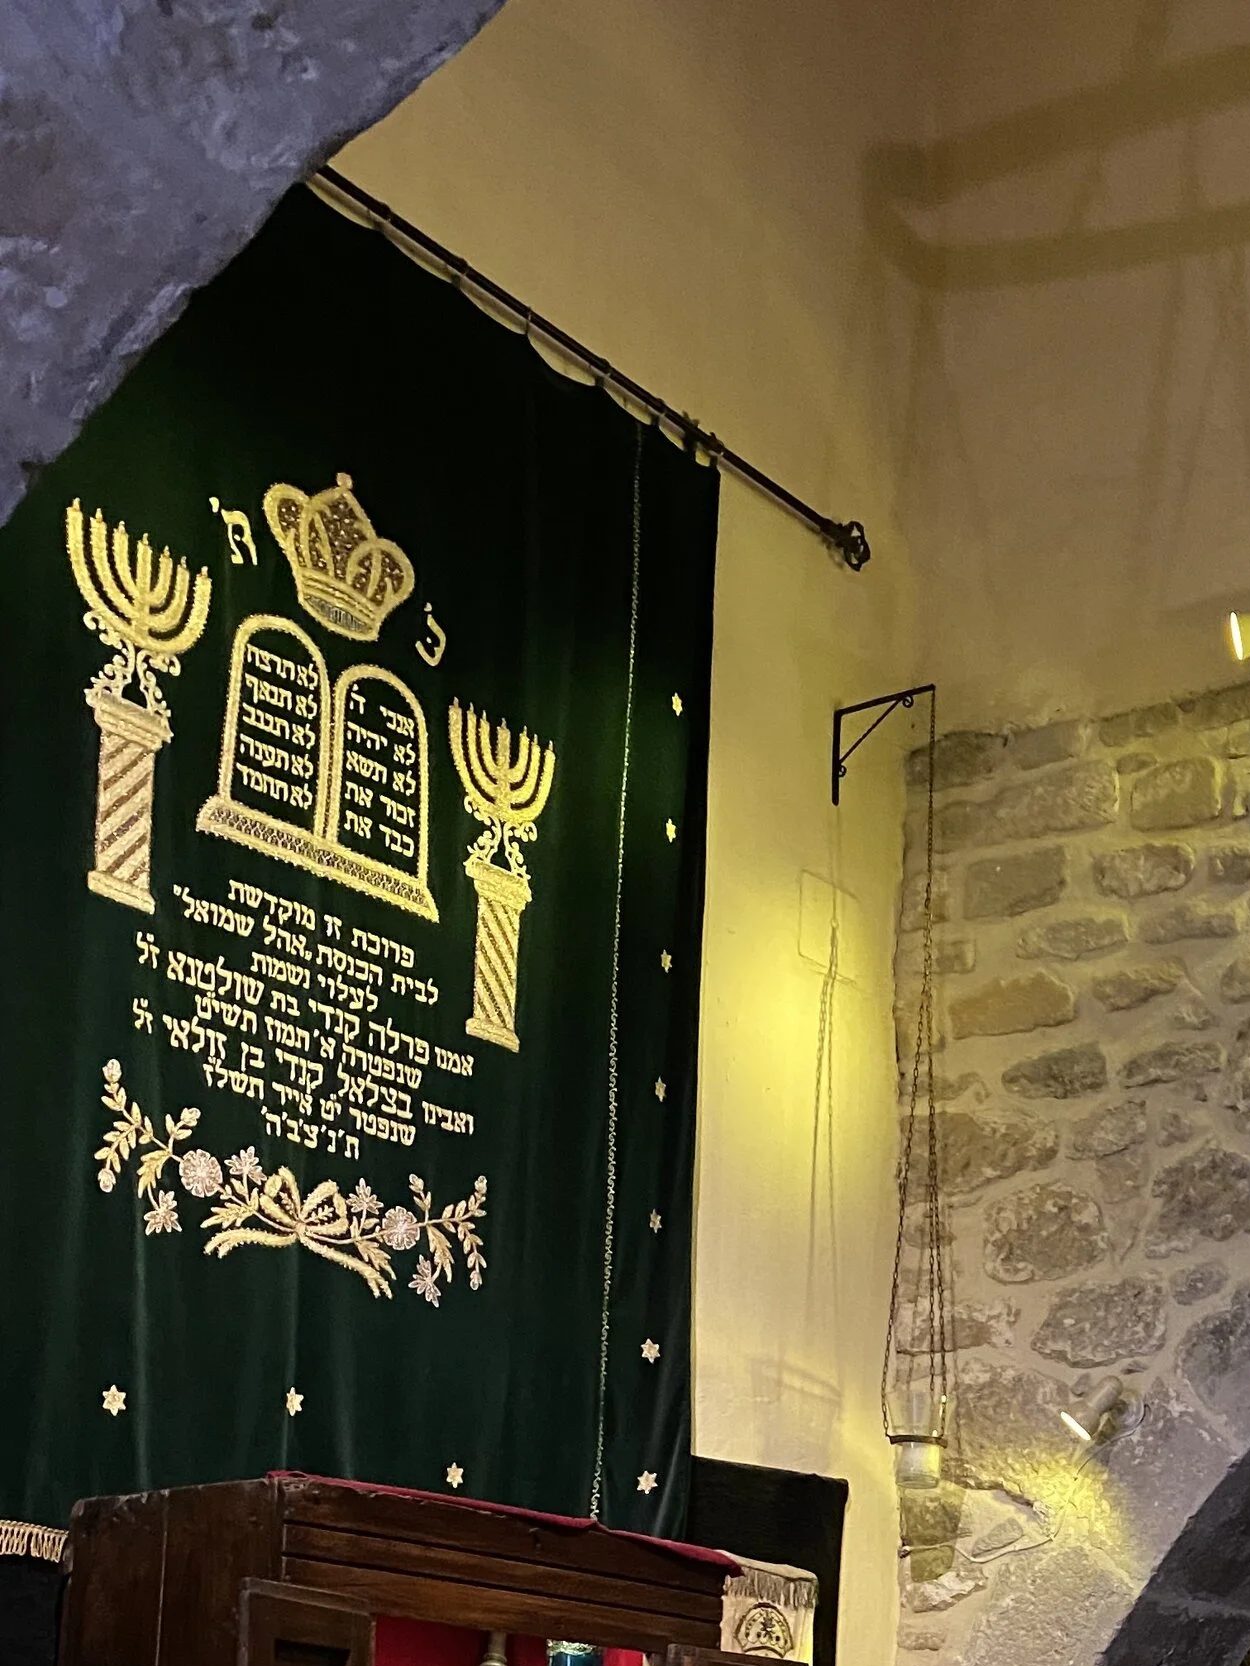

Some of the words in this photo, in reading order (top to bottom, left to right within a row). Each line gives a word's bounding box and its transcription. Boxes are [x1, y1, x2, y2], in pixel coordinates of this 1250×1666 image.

[247, 643, 295, 681] תרצח
[297, 663, 319, 690] לא
[245, 673, 292, 711] תנאף
[295, 694, 318, 720] לא
[242, 702, 290, 740] תגנב
[291, 723, 316, 750] לא
[346, 721, 388, 751] יהיה
[379, 705, 415, 739] אנכי
[240, 733, 289, 771] תענה
[291, 753, 314, 779] לא
[346, 750, 388, 785] תשא
[393, 743, 416, 766] לא
[236, 762, 288, 802] תחמד
[290, 783, 313, 810] לא
[344, 781, 373, 808] את
[392, 770, 416, 796] לא
[344, 810, 373, 839] את
[379, 794, 416, 828] זכור
[379, 824, 415, 857] כבד
[228, 879, 316, 931] מוקדשת
[324, 914, 343, 940] זו
[316, 944, 383, 987] הכנסת
[351, 928, 415, 969] פרוכת
[250, 951, 311, 990] נשמות
[270, 990, 300, 1017] בת
[390, 973, 439, 1006] לבית
[264, 1016, 310, 1052] תמוז
[308, 998, 361, 1043] קנדי
[241, 1041, 265, 1072] בן
[368, 1017, 430, 1066] פרלה
[275, 1048, 324, 1094] קנדי
[342, 1042, 422, 1089] שנפטרה
[434, 1046, 474, 1077] אמנו
[271, 1081, 313, 1116] אייר
[337, 1062, 413, 1119] בצלאל
[349, 1106, 416, 1146] שנפטר
[422, 1101, 474, 1135] ואבינו
